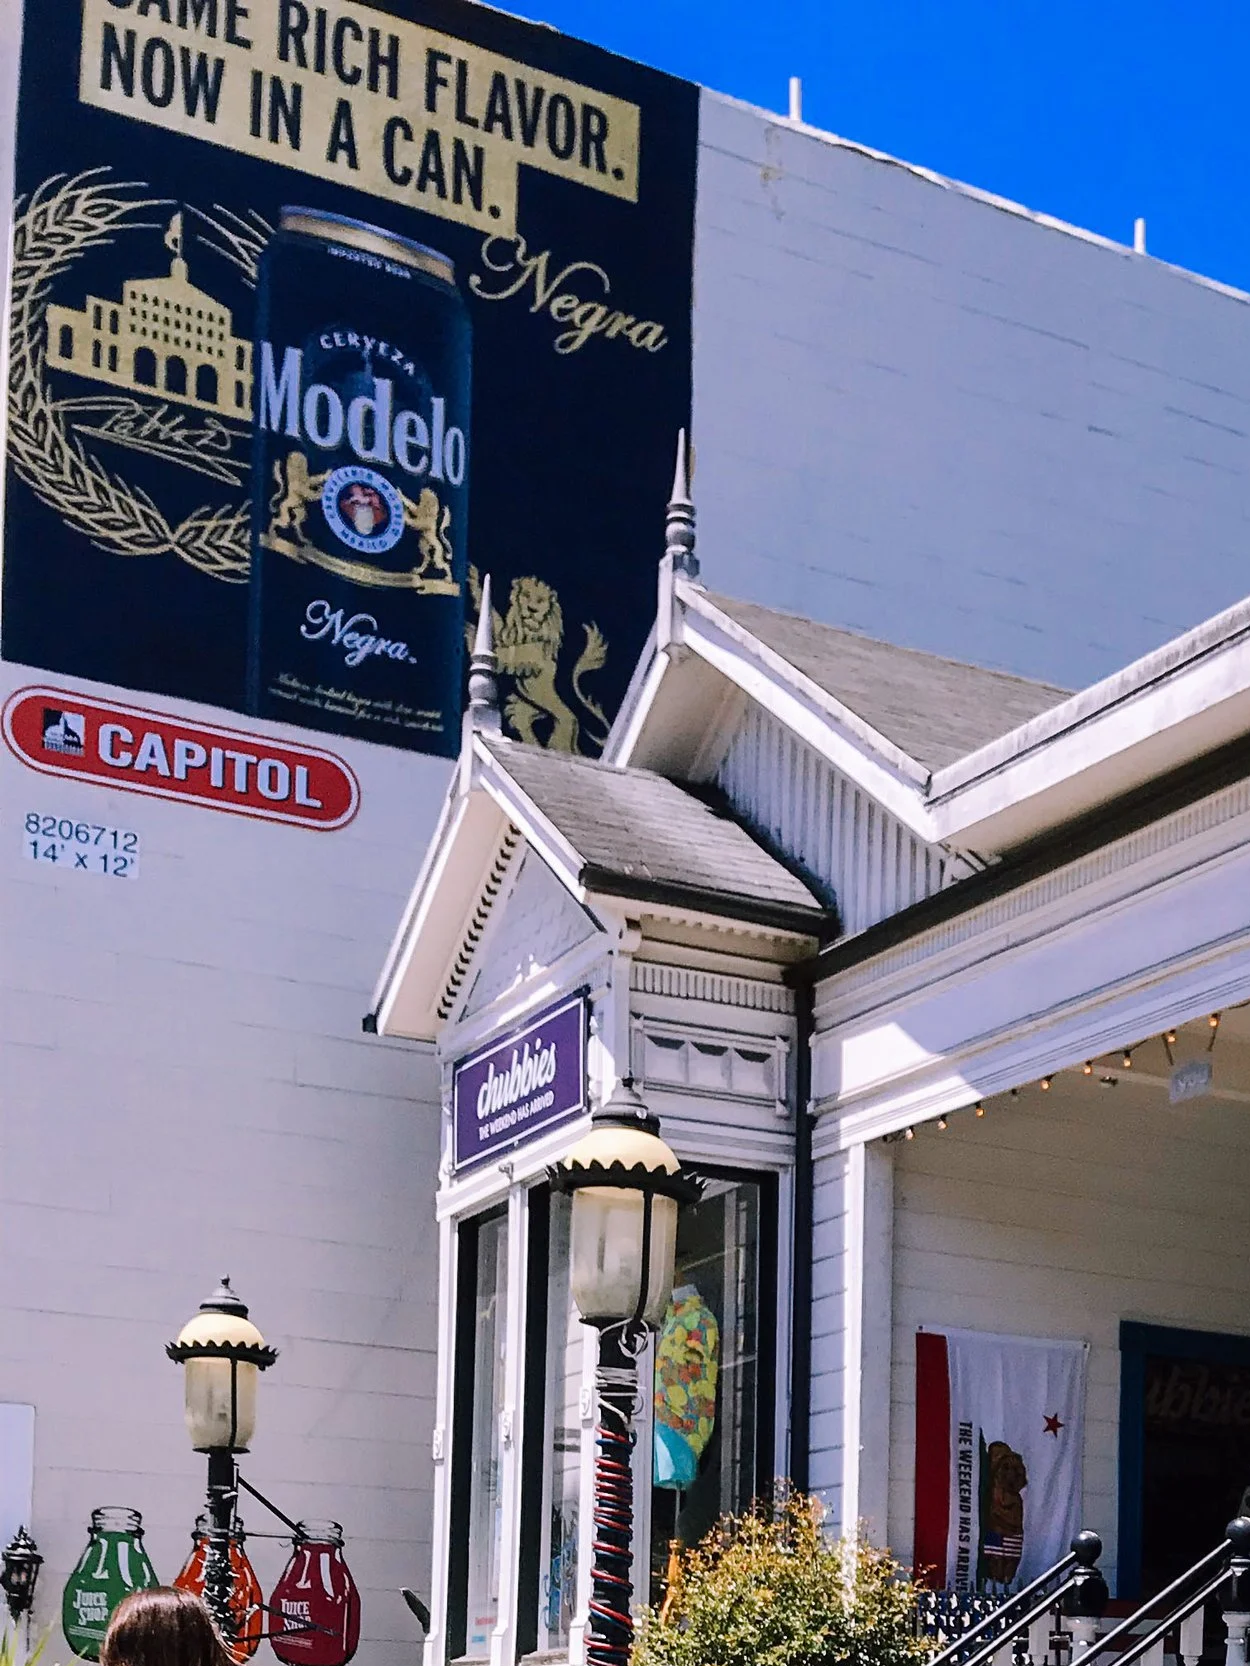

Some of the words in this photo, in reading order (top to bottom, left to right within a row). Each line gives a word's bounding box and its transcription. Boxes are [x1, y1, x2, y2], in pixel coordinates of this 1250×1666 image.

[100, 22, 225, 124] NOW
[250, 69, 304, 151] IN
[326, 98, 360, 170] A
[383, 116, 501, 219] CAN.
[278, 0, 400, 99] RICH
[425, 47, 626, 181] FLAVOR.
[468, 233, 668, 354] Negra
[320, 331, 415, 376] CERVEZA
[259, 339, 466, 487] Modelo
[300, 600, 412, 666] Negra
[97, 723, 323, 809] CAPITOL
[25, 812, 138, 854] 8206712
[29, 840, 65, 863] 14'
[99, 853, 134, 878] 12'
[476, 1037, 556, 1120] chubbies
[958, 1420, 973, 1446] THE
[958, 1450, 973, 1513] WEEKEND
[958, 1516, 972, 1542] HAS
